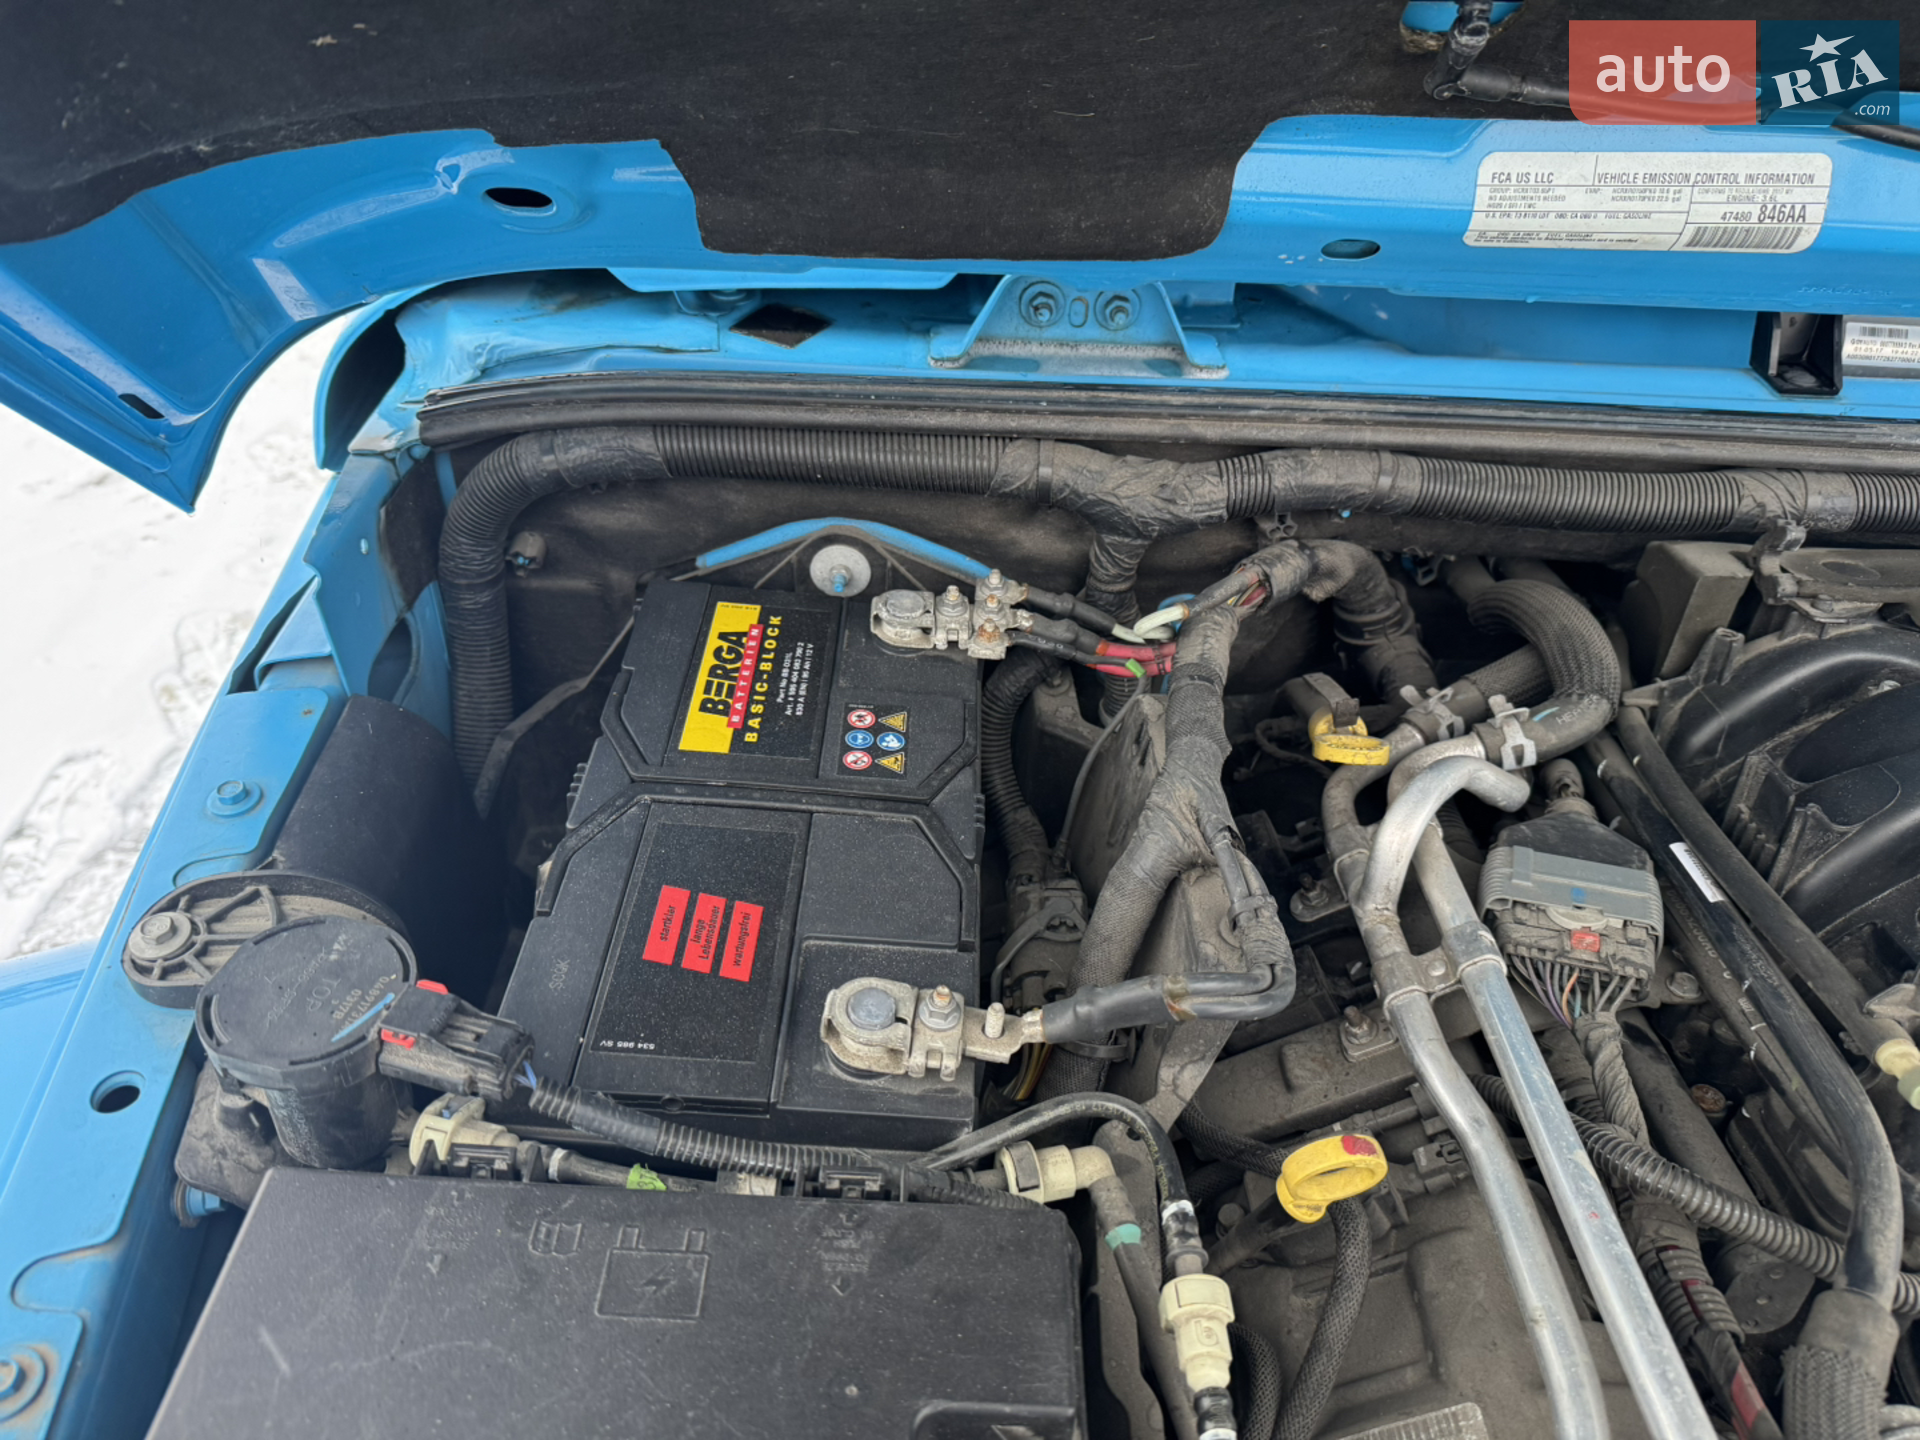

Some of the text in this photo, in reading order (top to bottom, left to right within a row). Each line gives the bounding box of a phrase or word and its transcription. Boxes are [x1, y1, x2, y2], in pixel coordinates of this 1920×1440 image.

[1491, 172, 1554, 184] FCA US LLC
[1597, 172, 1815, 185] VEHICLE EMISSION CONTROL INFORMATION
[1720, 204, 1807, 223] 47480 846AA
[698, 630, 748, 718] BERGA
[731, 627, 761, 724] BATTERIEN
[744, 615, 783, 743] BASIC-BLOCK
[307, 977, 342, 1013] TOP
